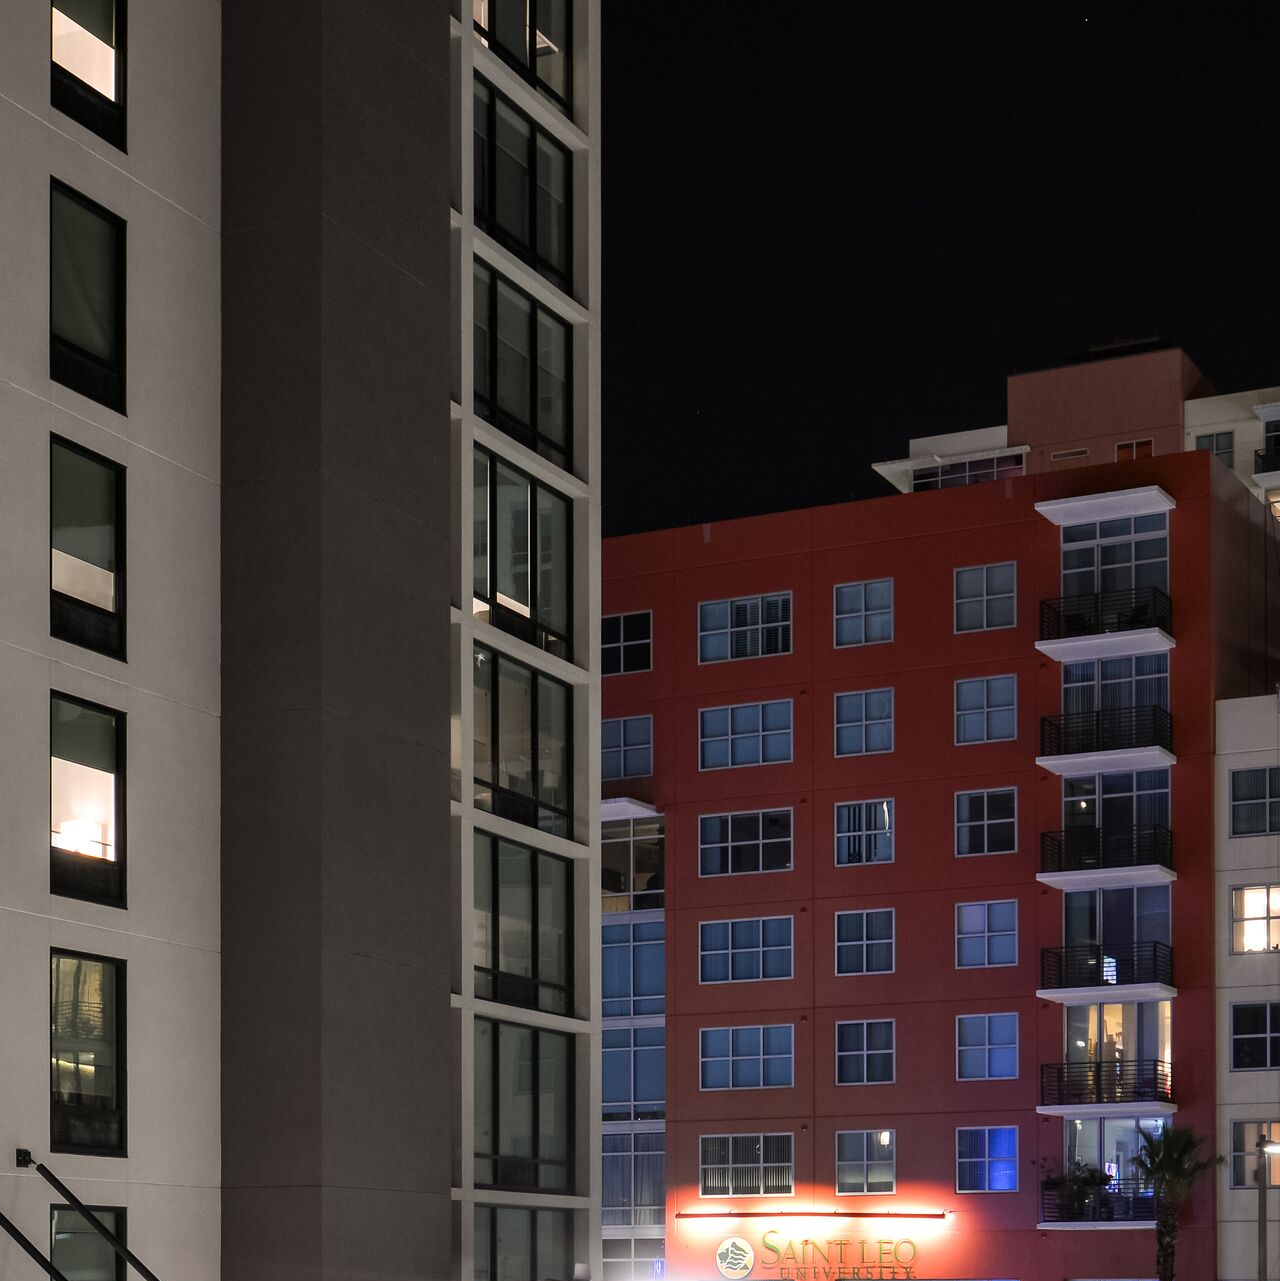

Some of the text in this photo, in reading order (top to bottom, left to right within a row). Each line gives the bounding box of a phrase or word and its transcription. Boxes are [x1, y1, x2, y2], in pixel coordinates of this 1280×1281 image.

[761, 1230, 917, 1266] SAINT LEO
[780, 1266, 913, 1280] UNIVERSITY
